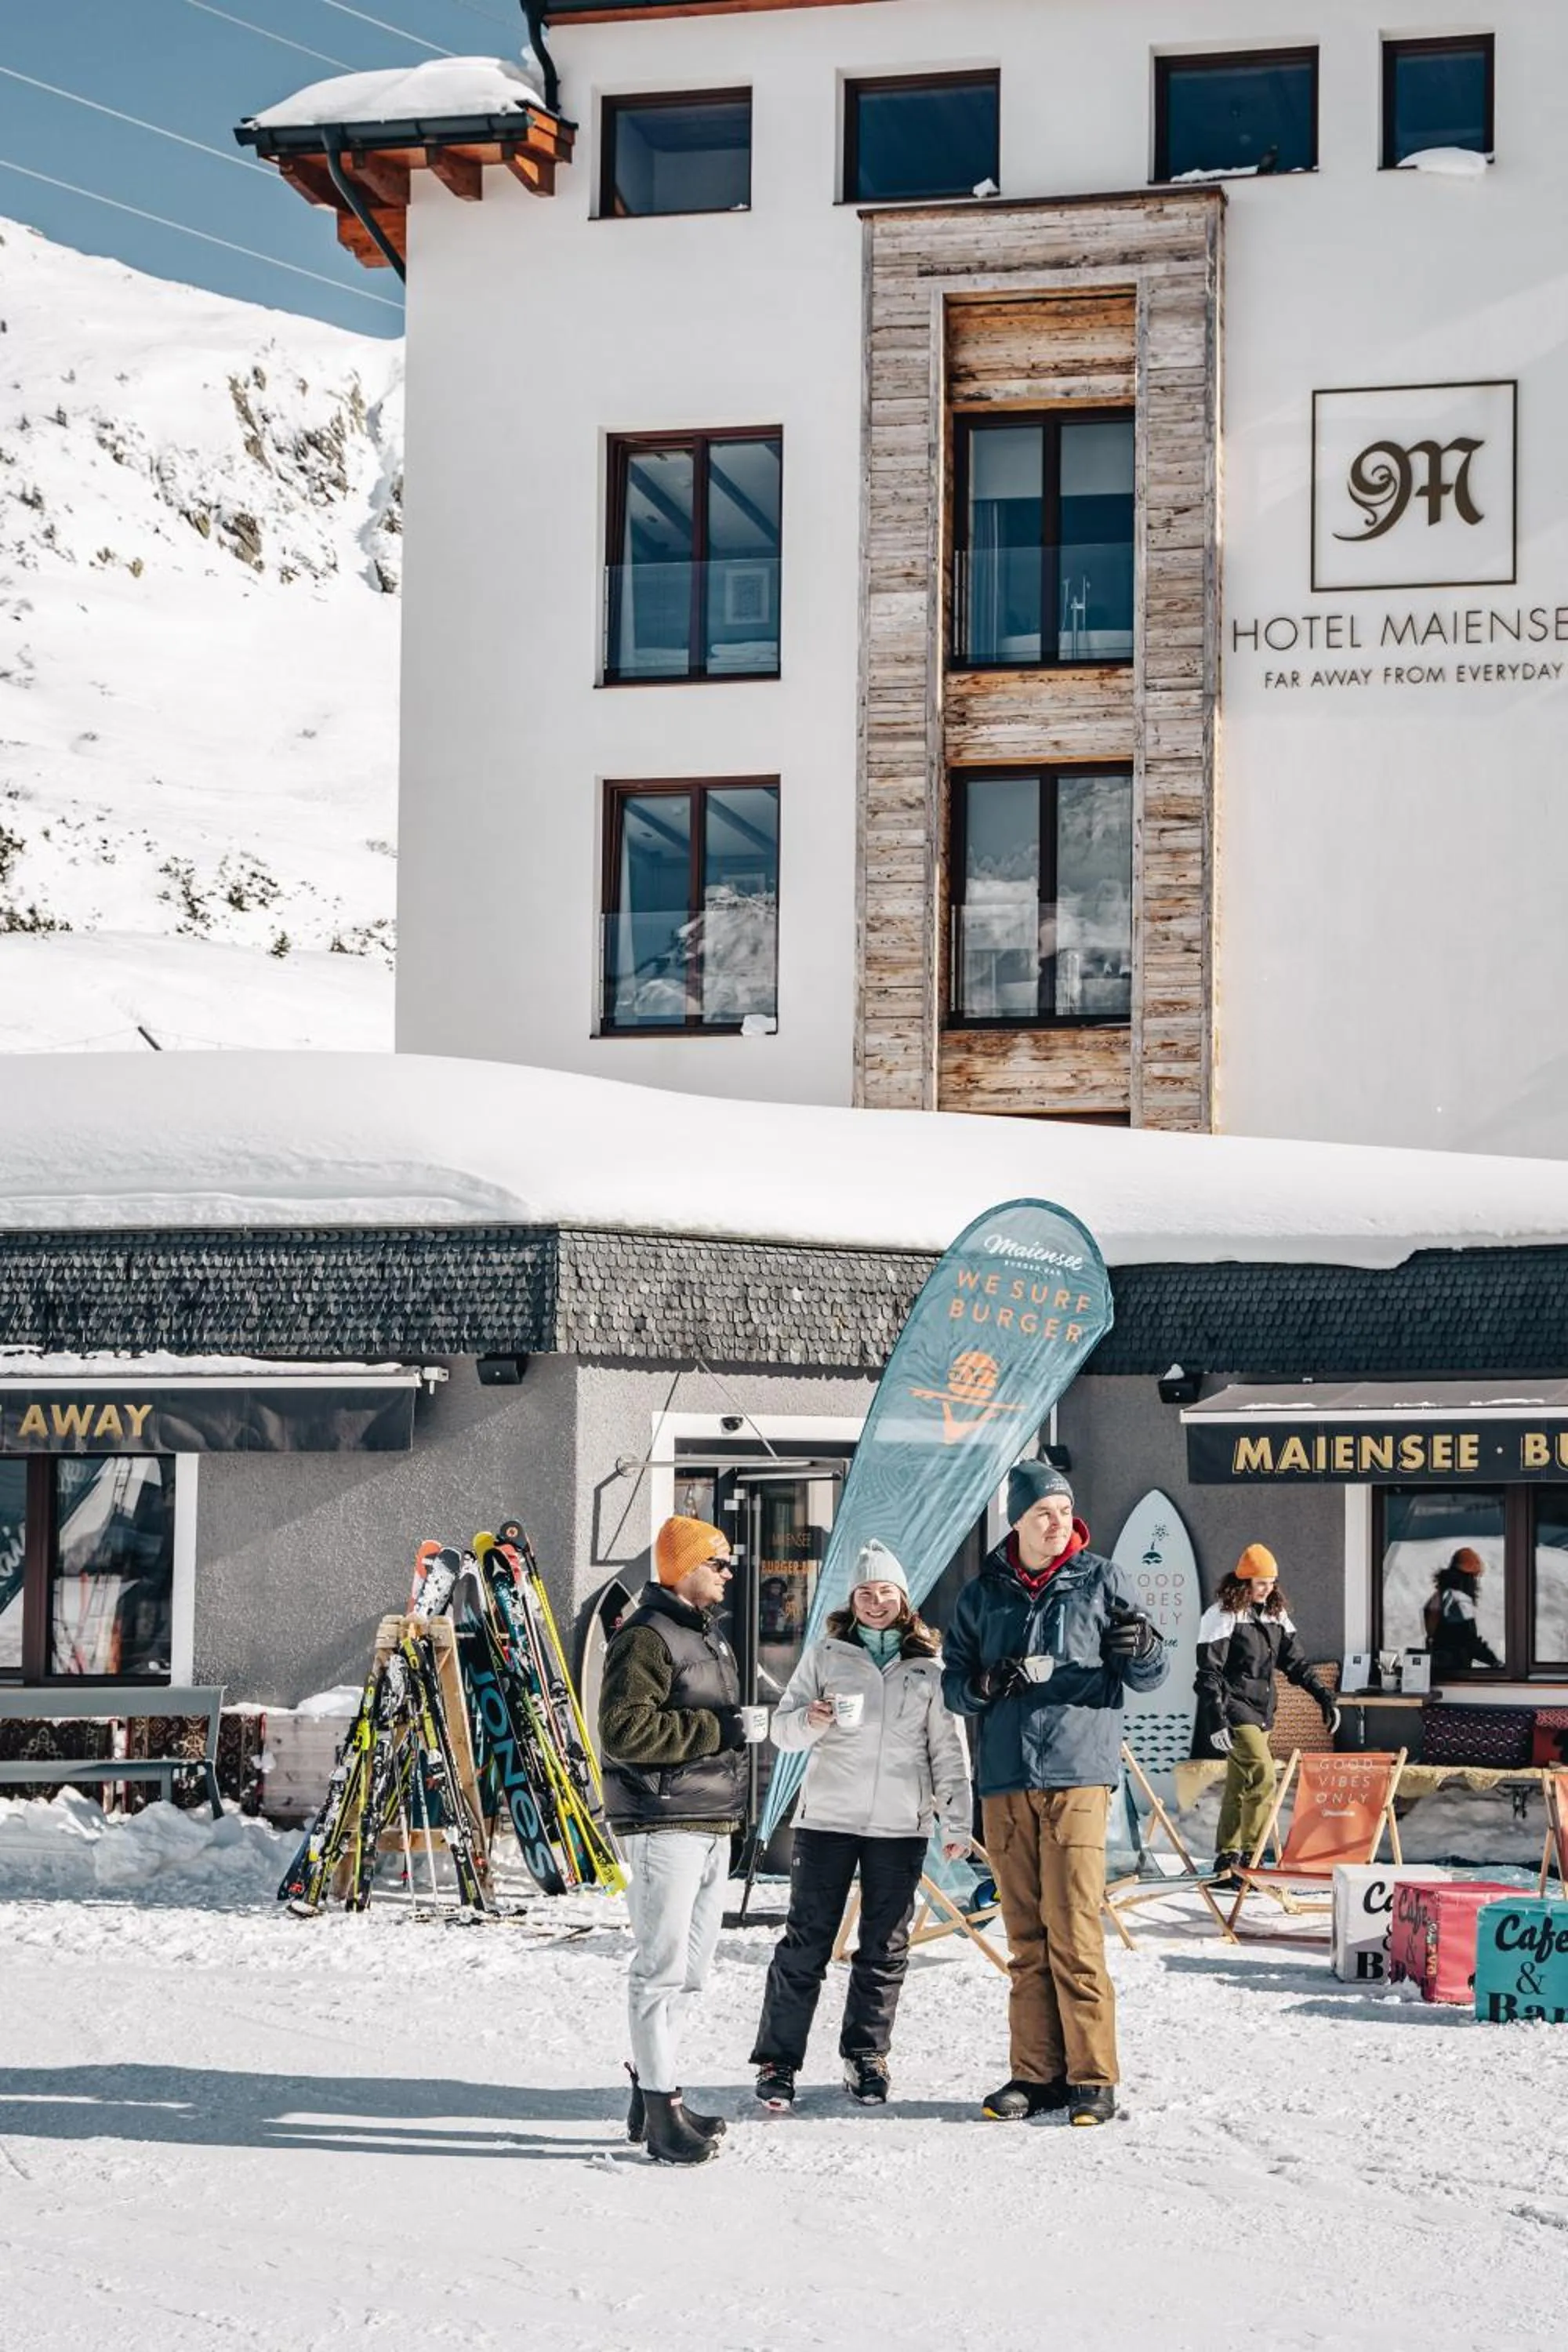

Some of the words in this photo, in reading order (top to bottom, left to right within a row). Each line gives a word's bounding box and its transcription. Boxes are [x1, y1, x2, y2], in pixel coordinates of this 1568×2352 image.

[1232, 614, 1362, 652] HOTEL
[1380, 608, 1568, 647] MAIENSE
[1265, 671, 1301, 689] FAR
[1310, 668, 1373, 688] AWAY
[1384, 665, 1446, 684] FROM
[1457, 662, 1563, 683] EVERYDAY
[984, 1233, 1083, 1271] Maiensee
[957, 1268, 1001, 1295] WE
[1010, 1278, 1091, 1314] SURF
[949, 1298, 1083, 1343] BURGER
[17, 1403, 154, 1438] AWAY
[1232, 1434, 1480, 1474] MAIENSEE
[1138, 1573, 1185, 1588] OOD
[1145, 1592, 1183, 1607] BES
[1160, 1612, 1182, 1625] LY
[1319, 1759, 1374, 1770] GOOD
[1319, 1774, 1371, 1788] VIBES
[1316, 1791, 1369, 1805] ONLY
[1495, 1914, 1568, 1964] Cafe
[1515, 1961, 1548, 1995] &
